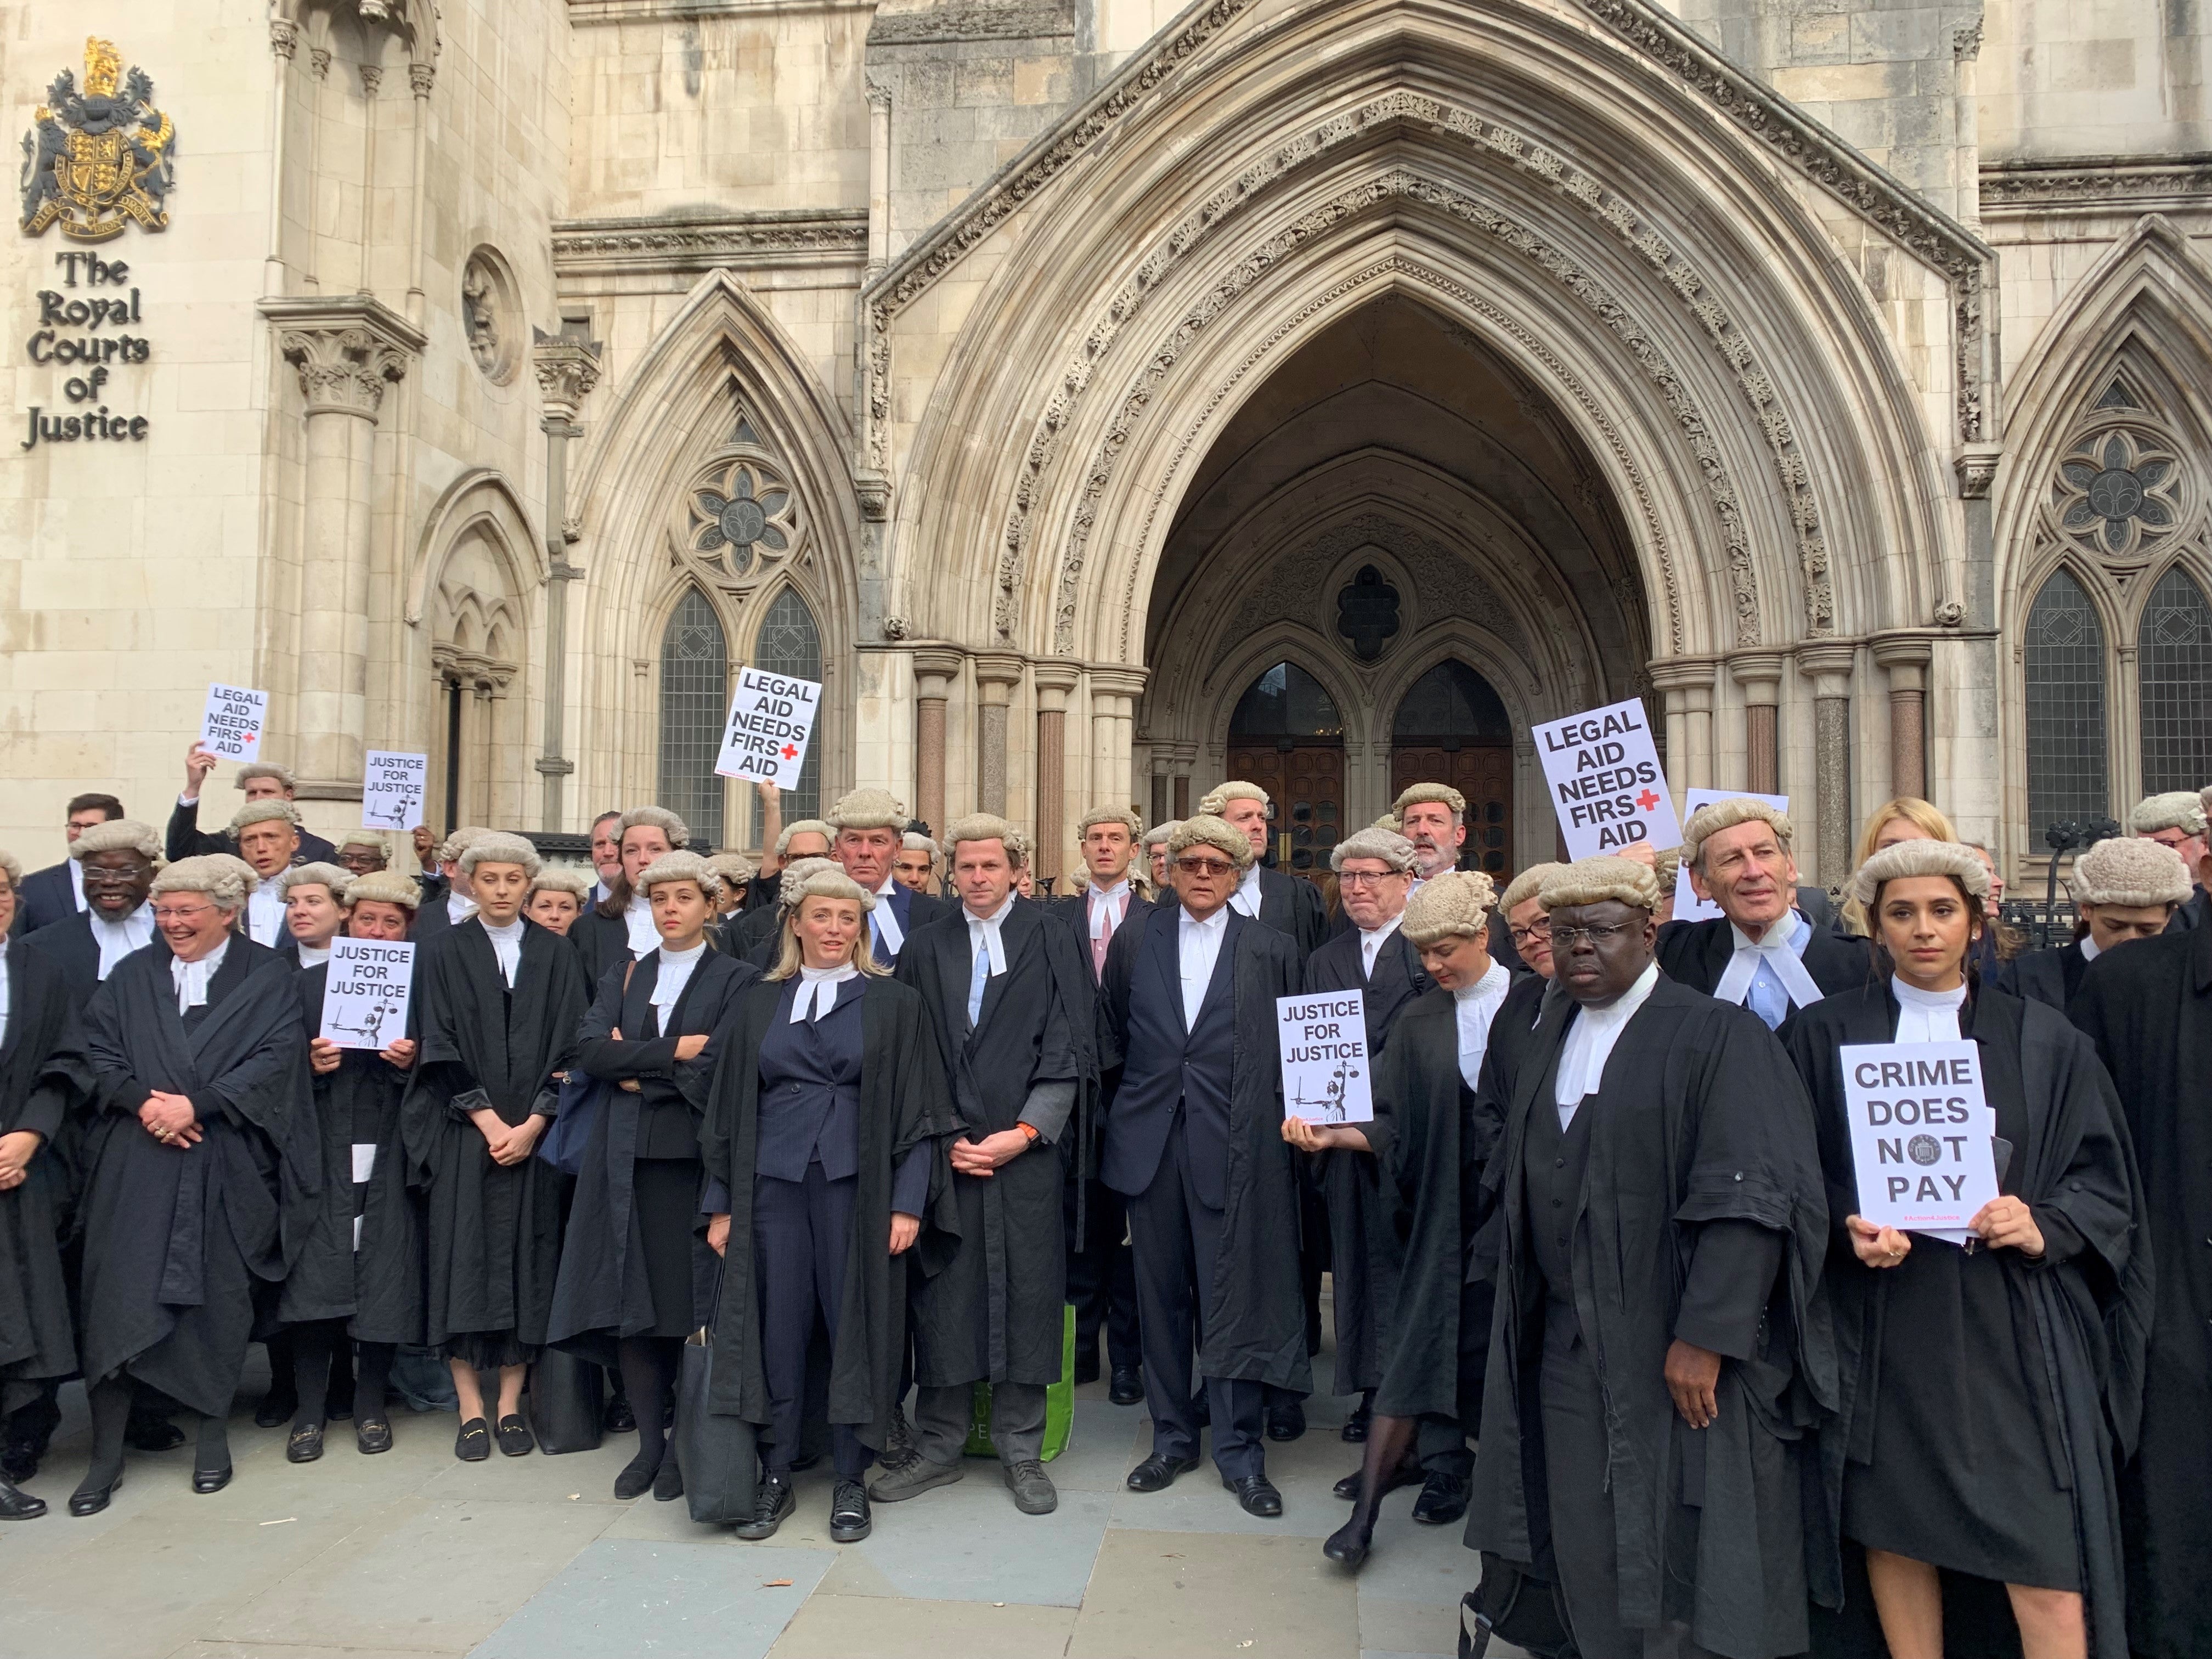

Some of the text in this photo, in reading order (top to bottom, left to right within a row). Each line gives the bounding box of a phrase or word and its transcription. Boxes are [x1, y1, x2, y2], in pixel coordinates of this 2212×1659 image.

[119, 196, 152, 226] DROIT
[55, 251, 129, 286] The
[36, 287, 141, 330] Royal
[26, 329, 149, 364] Courts
[64, 365, 109, 403] of
[20, 405, 148, 449] Justice
[213, 687, 263, 706] LEGAL
[743, 673, 813, 703] LEGAL
[222, 703, 250, 715] AID
[753, 696, 793, 718] AID
[207, 713, 259, 731] NEEDS
[731, 710, 806, 742] NEEDS
[1544, 710, 1641, 752] LEGAL
[215, 741, 242, 754] AID
[1577, 742, 1625, 773] AID
[370, 757, 424, 769] JUSTICE
[383, 770, 408, 781] FOR
[738, 755, 778, 777] AID
[368, 782, 421, 794] JUSTICE
[1558, 761, 1656, 804] NEEDS
[1599, 820, 1647, 850] AID
[335, 946, 410, 963] JUSTICE
[353, 965, 387, 979] FOR
[330, 981, 405, 998] JUSTICE
[1283, 1000, 1359, 1022] JUSTICE
[1304, 1023, 1341, 1041] FOR
[1286, 1042, 1363, 1063] JUSTICE
[1855, 1058, 1973, 1089] CRIME
[1867, 1097, 1970, 1126] DOES
[1887, 1175, 1967, 1203] PAY
